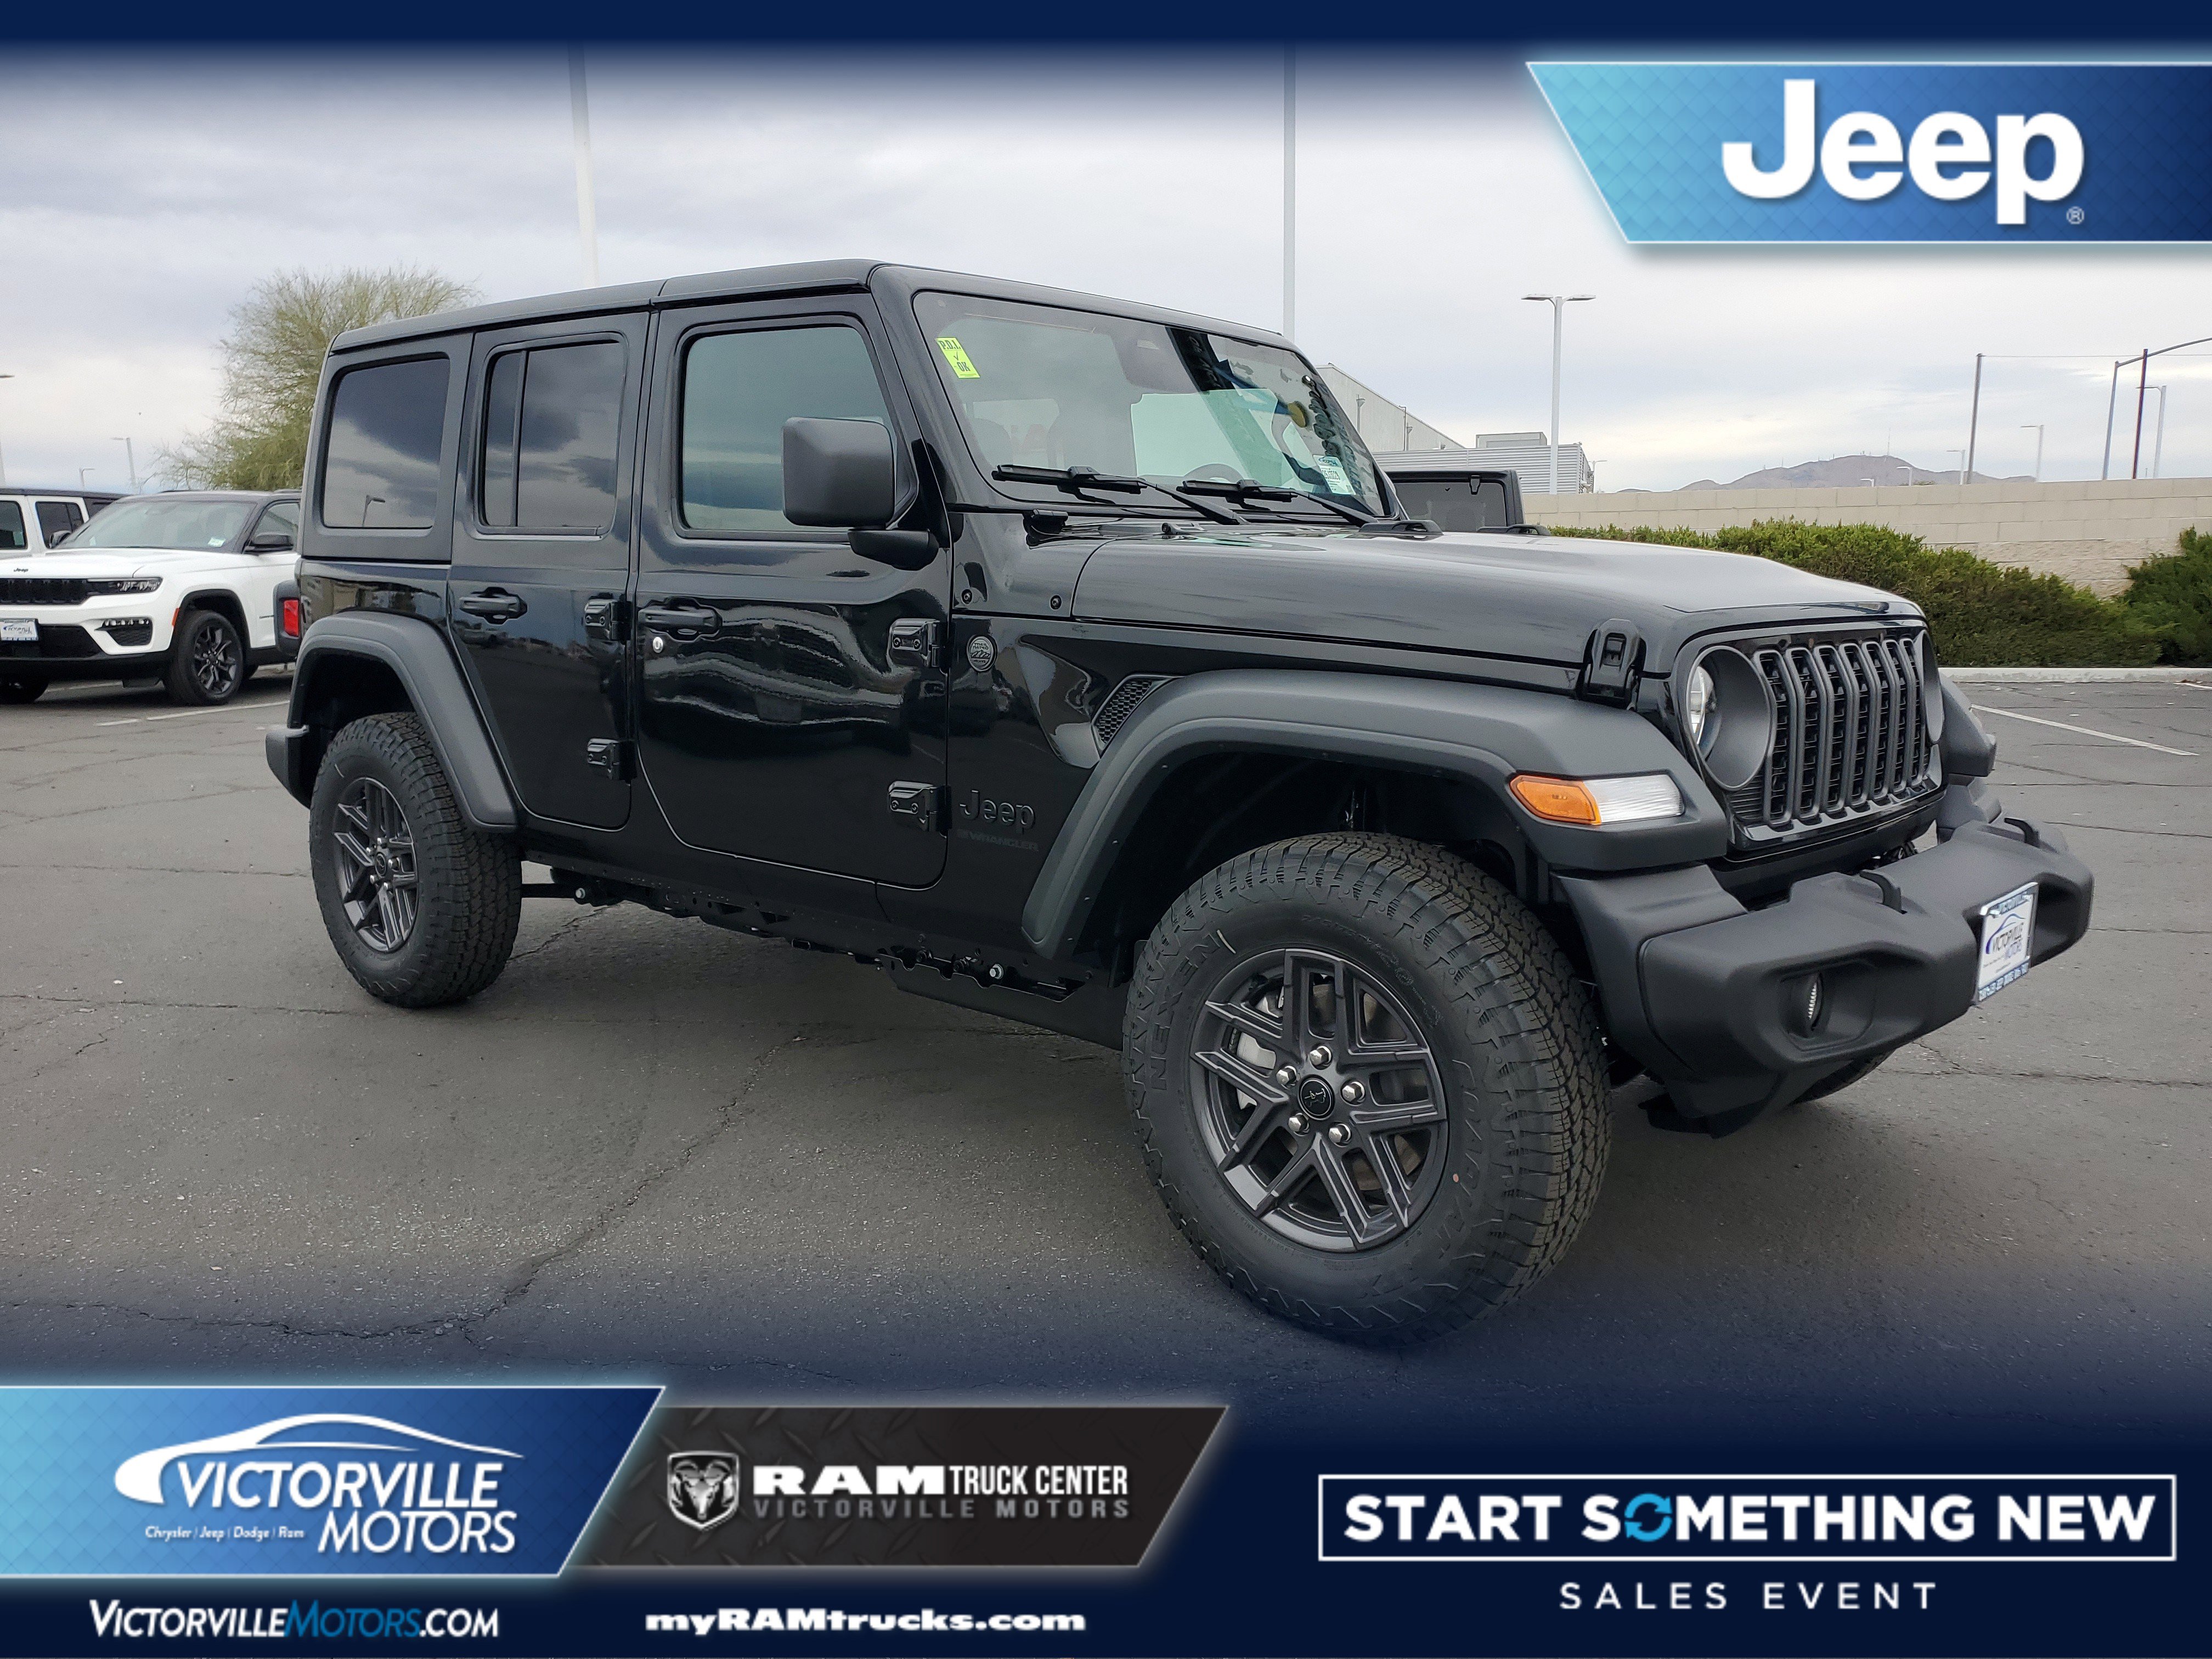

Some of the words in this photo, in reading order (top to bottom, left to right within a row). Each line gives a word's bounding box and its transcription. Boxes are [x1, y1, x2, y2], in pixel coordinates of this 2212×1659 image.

[938, 340, 961, 350] P.D.I.
[957, 362, 971, 372] OK
[959, 789, 1036, 834] Jeep
[1149, 932, 1222, 1091] NEXEN
